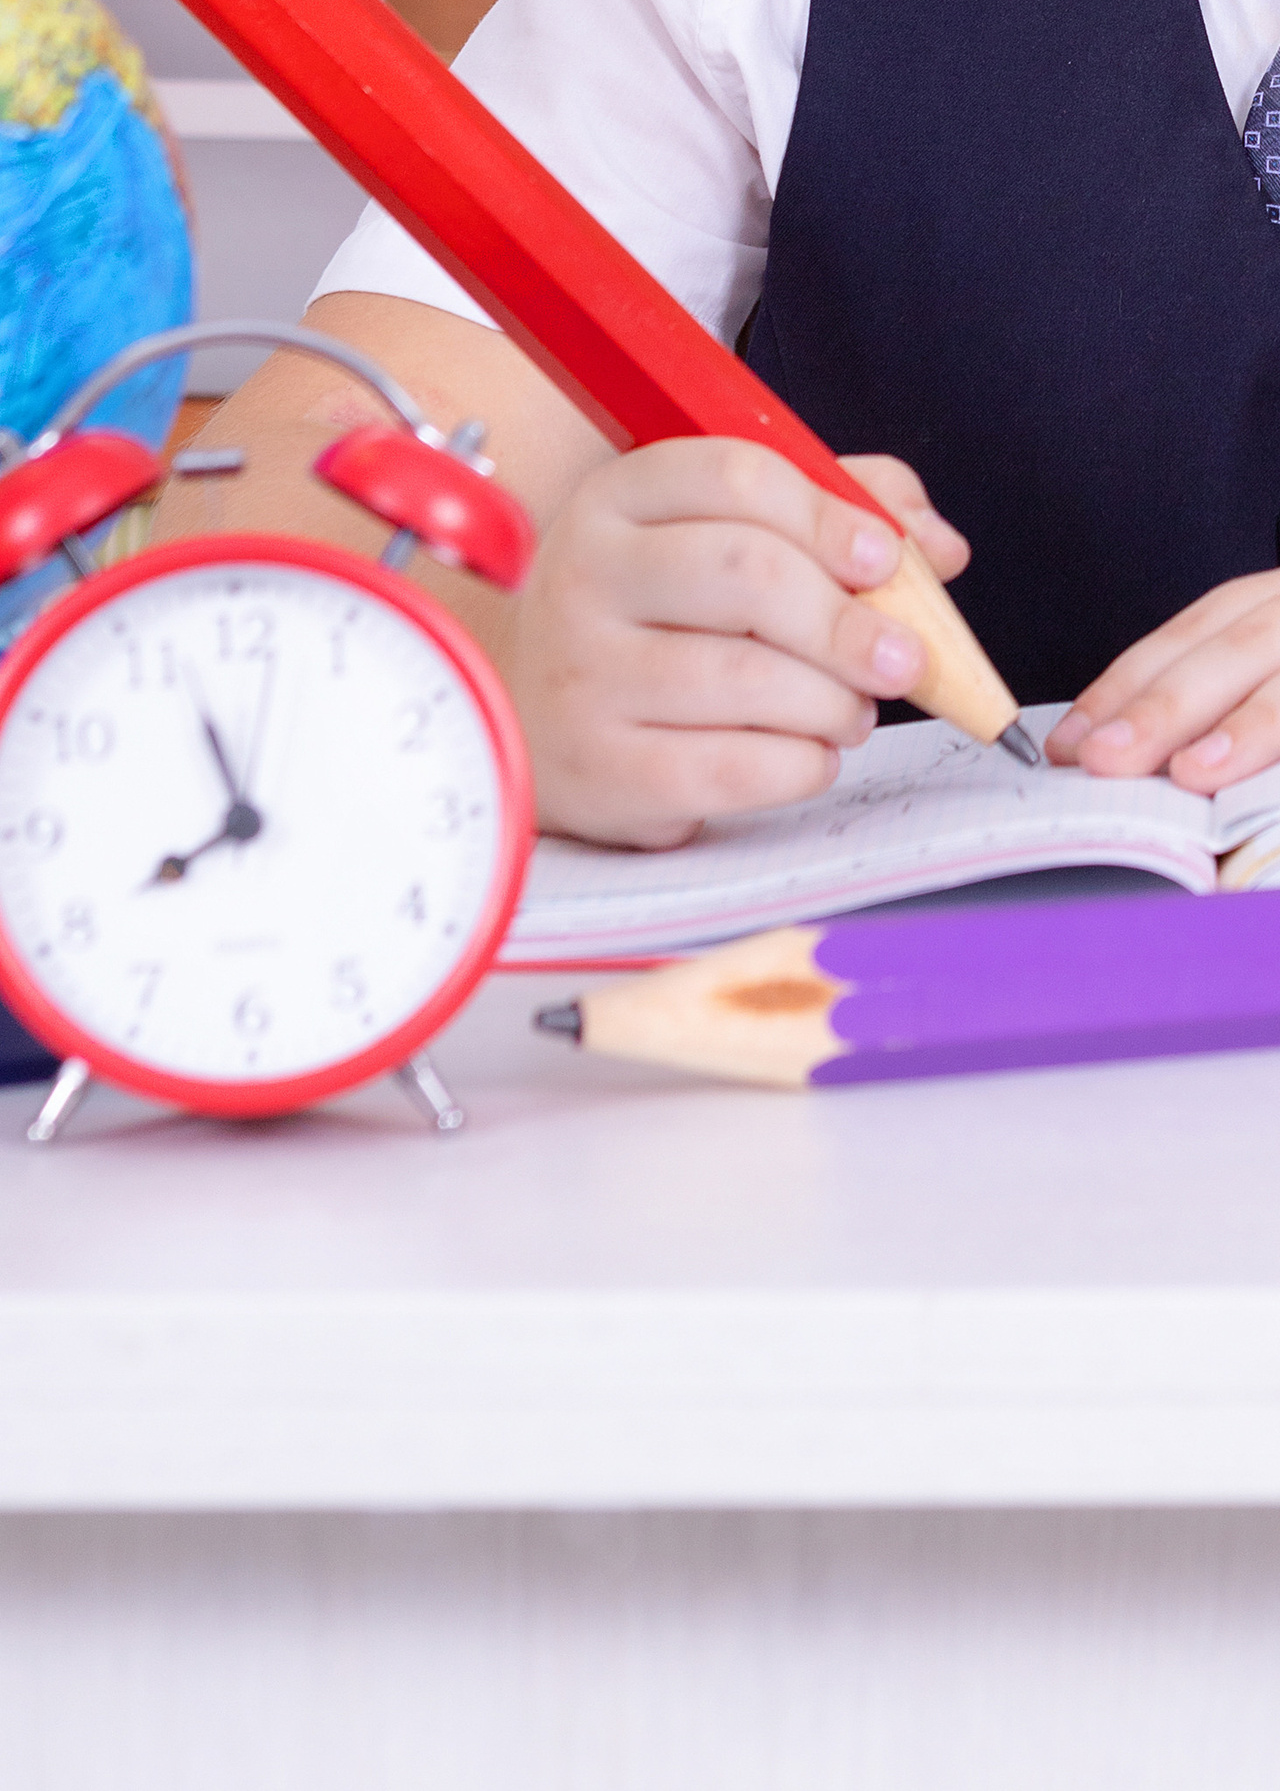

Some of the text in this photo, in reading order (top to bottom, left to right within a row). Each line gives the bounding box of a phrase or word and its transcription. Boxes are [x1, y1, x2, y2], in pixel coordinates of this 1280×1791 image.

[126, 636, 177, 689] 11
[215, 610, 278, 663] 12
[329, 626, 348, 677] 1
[52, 712, 116, 764] 10
[399, 700, 432, 754] 2
[25, 807, 65, 855] 9
[427, 786, 463, 839] 3
[61, 899, 98, 951] 8
[397, 881, 428, 927] 4
[126, 959, 165, 1011] 7
[331, 955, 367, 1008] 5
[232, 985, 270, 1039] 6
